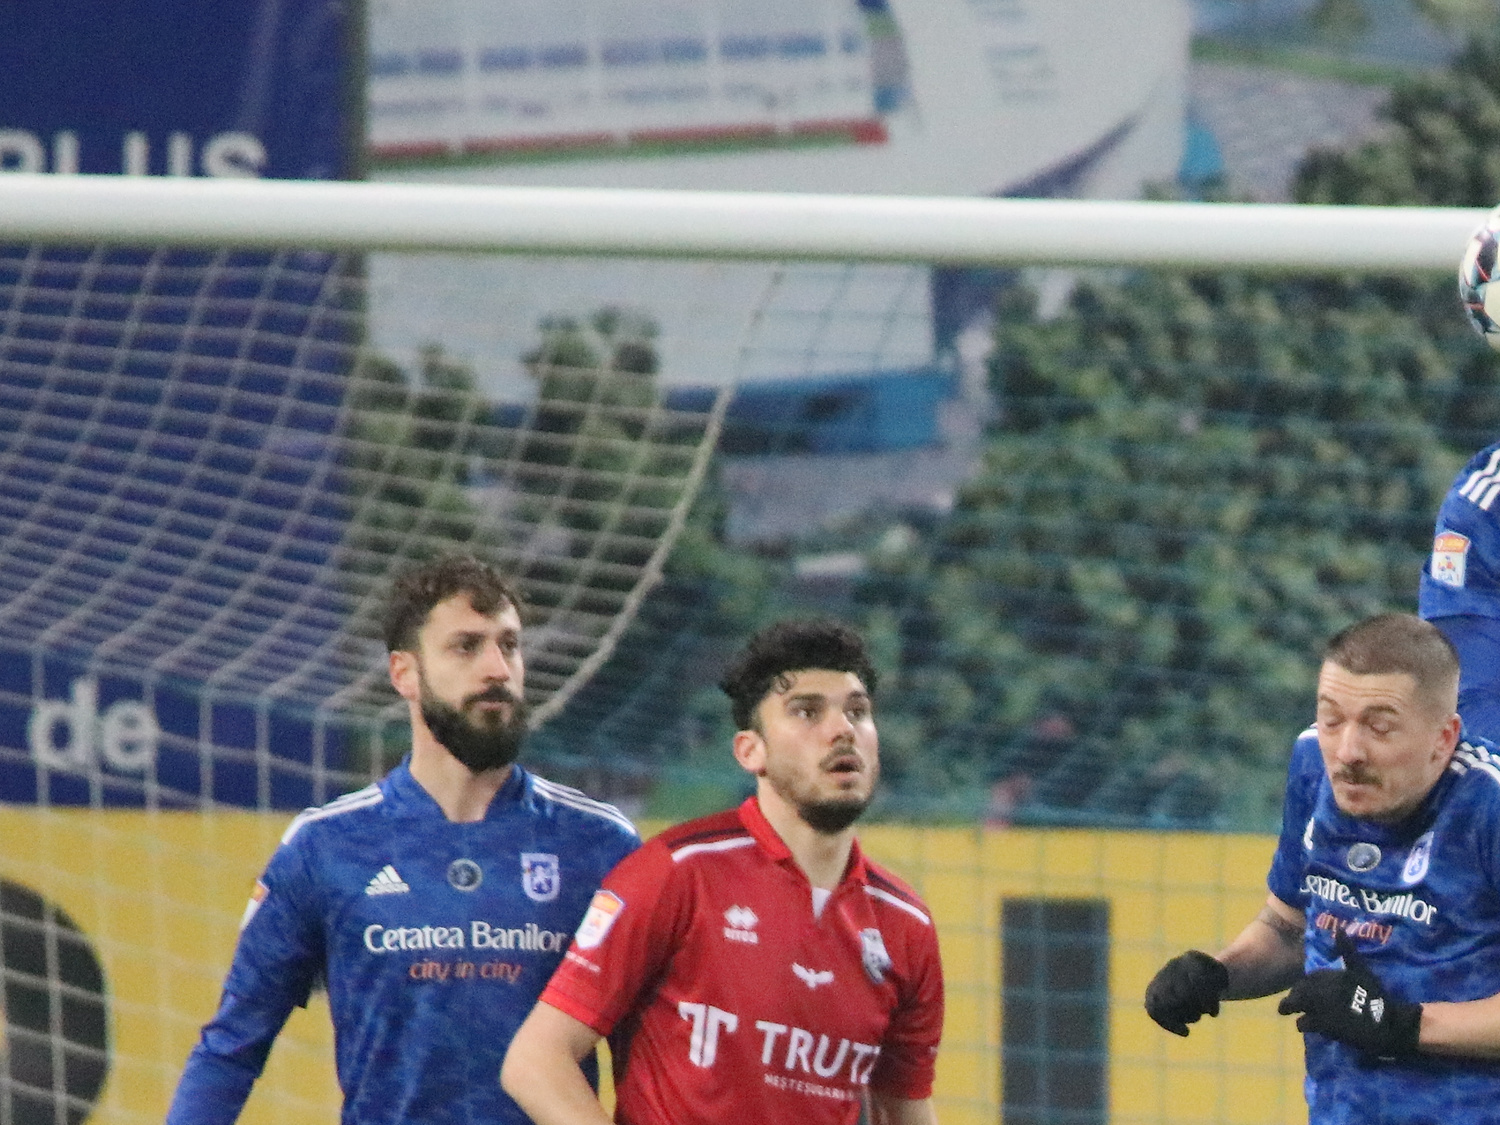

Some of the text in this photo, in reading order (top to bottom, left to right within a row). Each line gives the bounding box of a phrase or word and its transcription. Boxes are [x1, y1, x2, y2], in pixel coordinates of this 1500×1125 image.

[30, 677, 157, 770] de
[363, 920, 568, 953] Cetatea Banilor
[409, 958, 452, 982] city
[480, 957, 523, 984] city
[1351, 985, 1368, 1014] FCU
